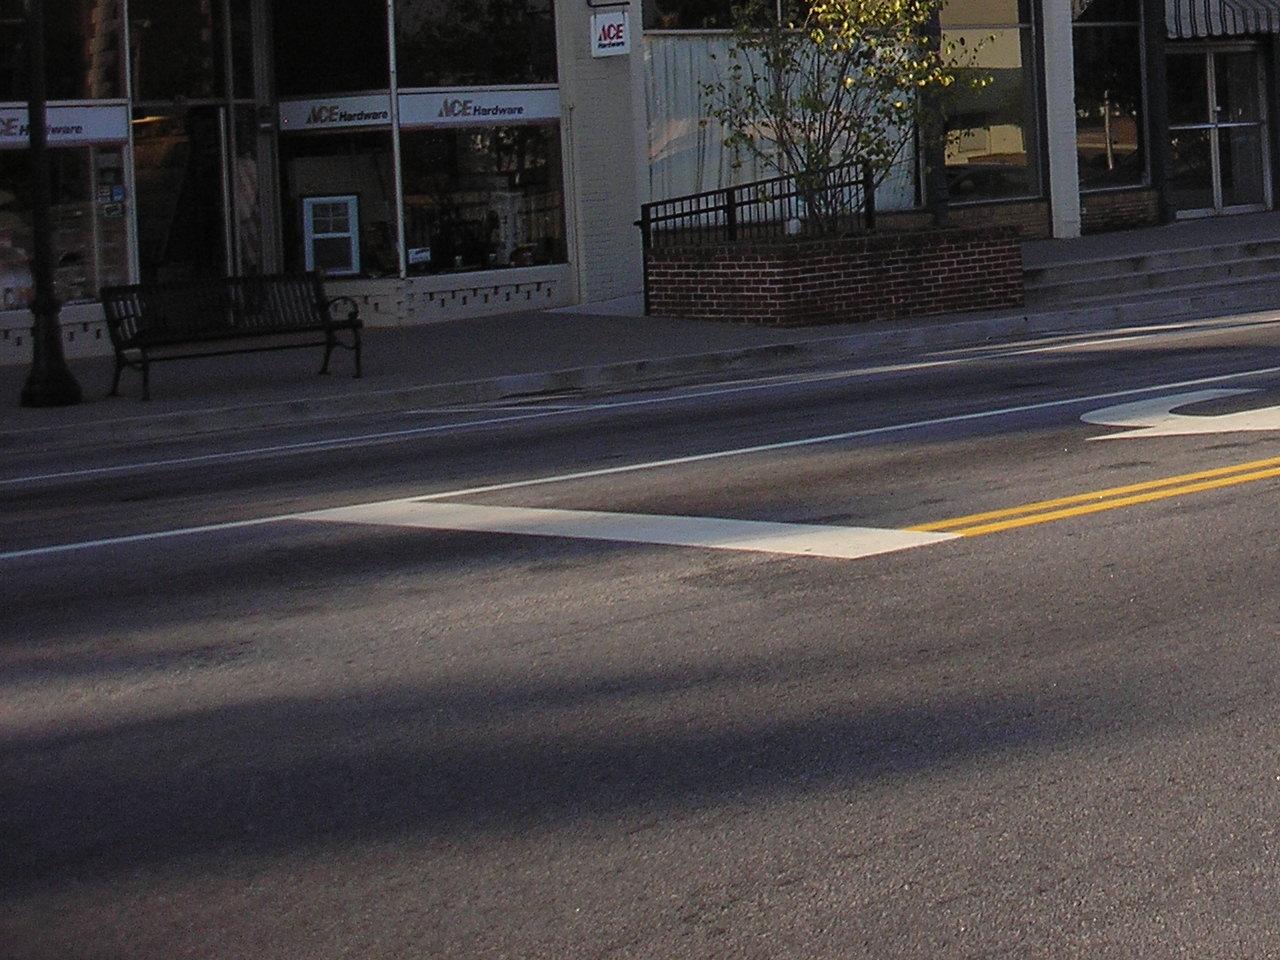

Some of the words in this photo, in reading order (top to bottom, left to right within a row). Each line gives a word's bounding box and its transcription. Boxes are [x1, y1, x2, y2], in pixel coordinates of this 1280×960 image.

[597, 22, 625, 42] ACE
[306, 105, 340, 125] ACE
[338, 110, 389, 123] Hardware
[438, 97, 473, 118] ACE
[473, 105, 525, 117] Hardware
